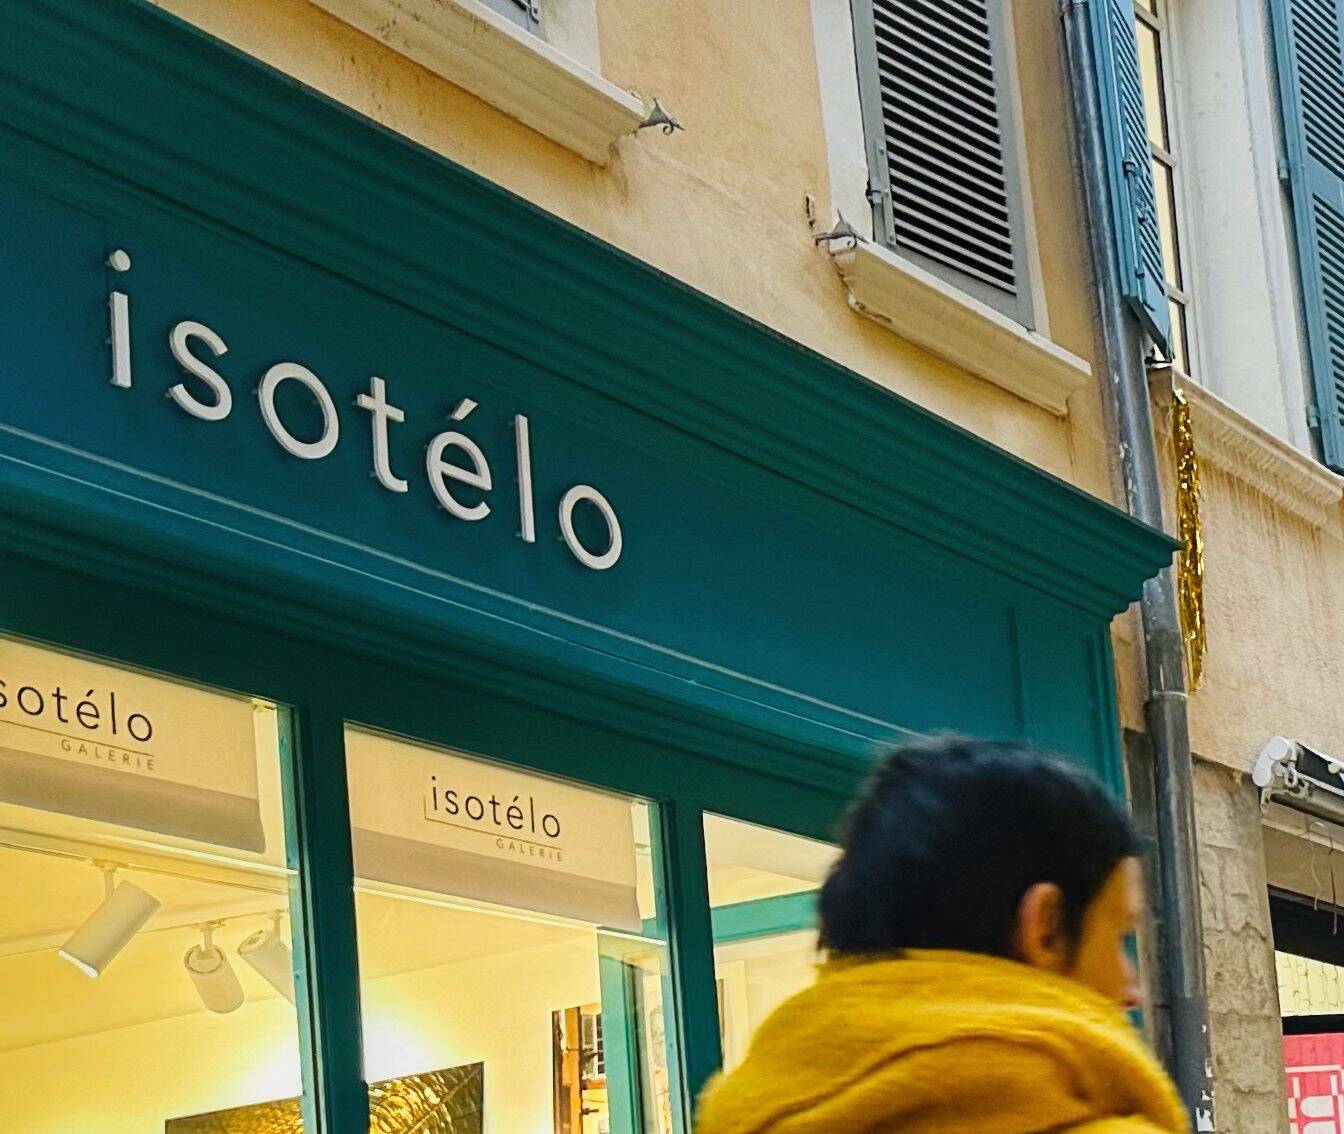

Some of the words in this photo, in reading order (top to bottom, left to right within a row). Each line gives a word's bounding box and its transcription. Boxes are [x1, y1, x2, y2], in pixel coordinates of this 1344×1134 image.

[105, 249, 623, 570] isotélo
[61, 738, 156, 770] GALERIE
[431, 775, 561, 838] isotélo
[496, 837, 563, 862] GALERIE
